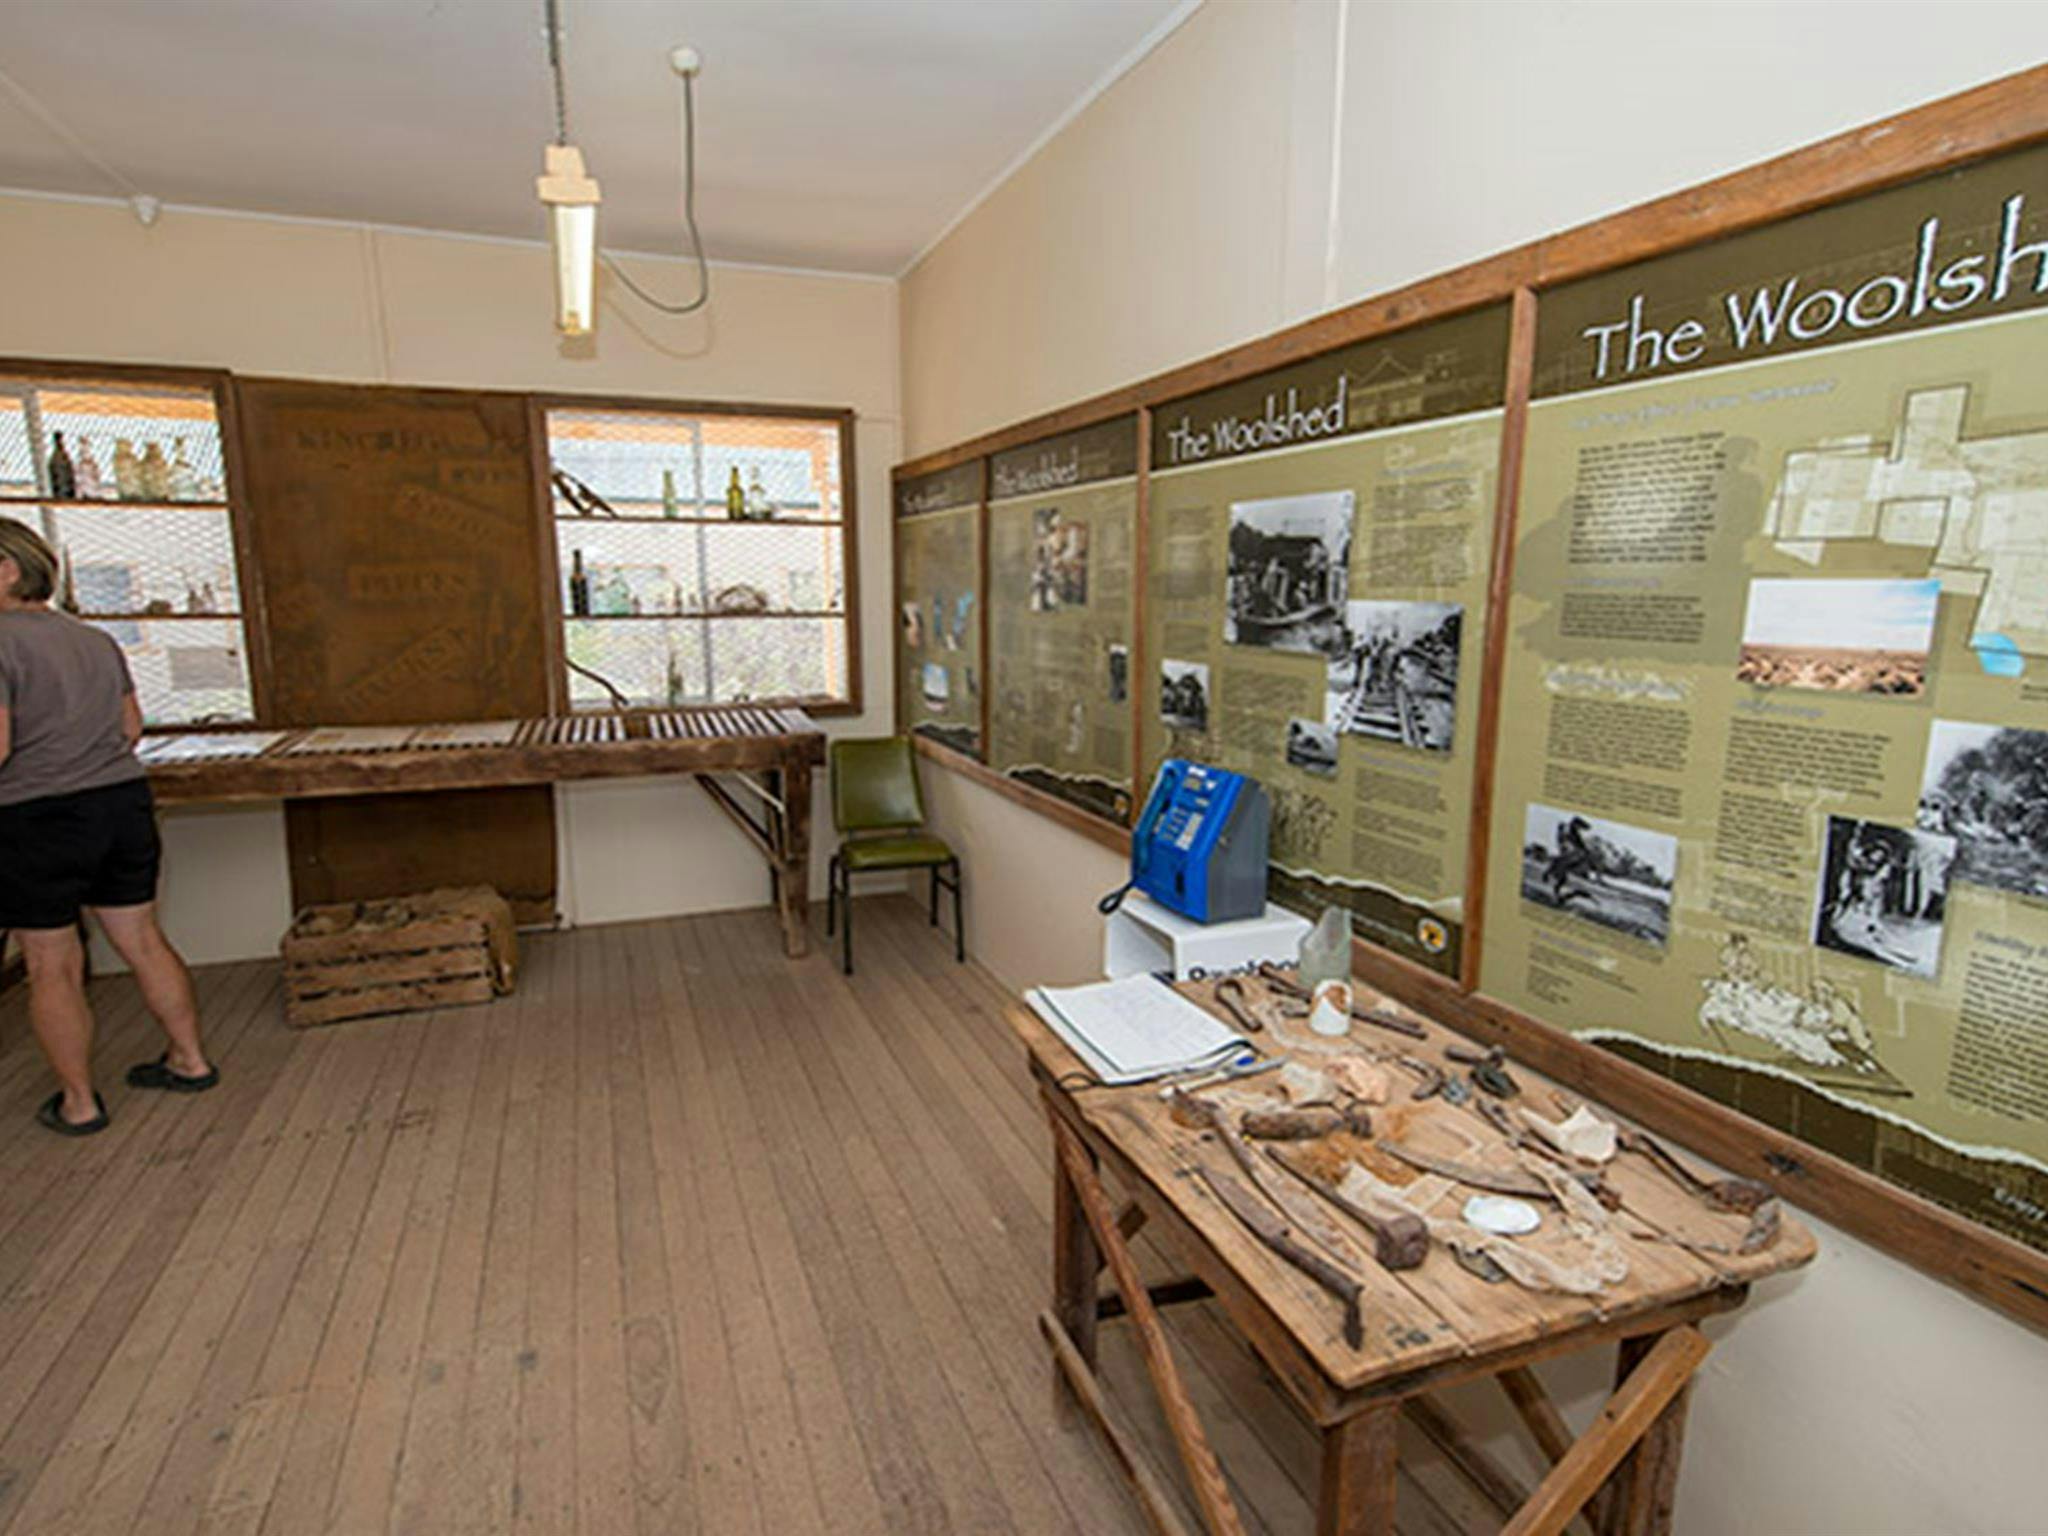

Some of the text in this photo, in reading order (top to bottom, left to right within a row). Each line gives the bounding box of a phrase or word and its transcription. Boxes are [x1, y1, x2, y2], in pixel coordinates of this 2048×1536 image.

[1582, 194, 2048, 381] The Woolsh
[1168, 374, 1348, 463] The Woolshed
[1016, 443, 1079, 490] Woolshed
